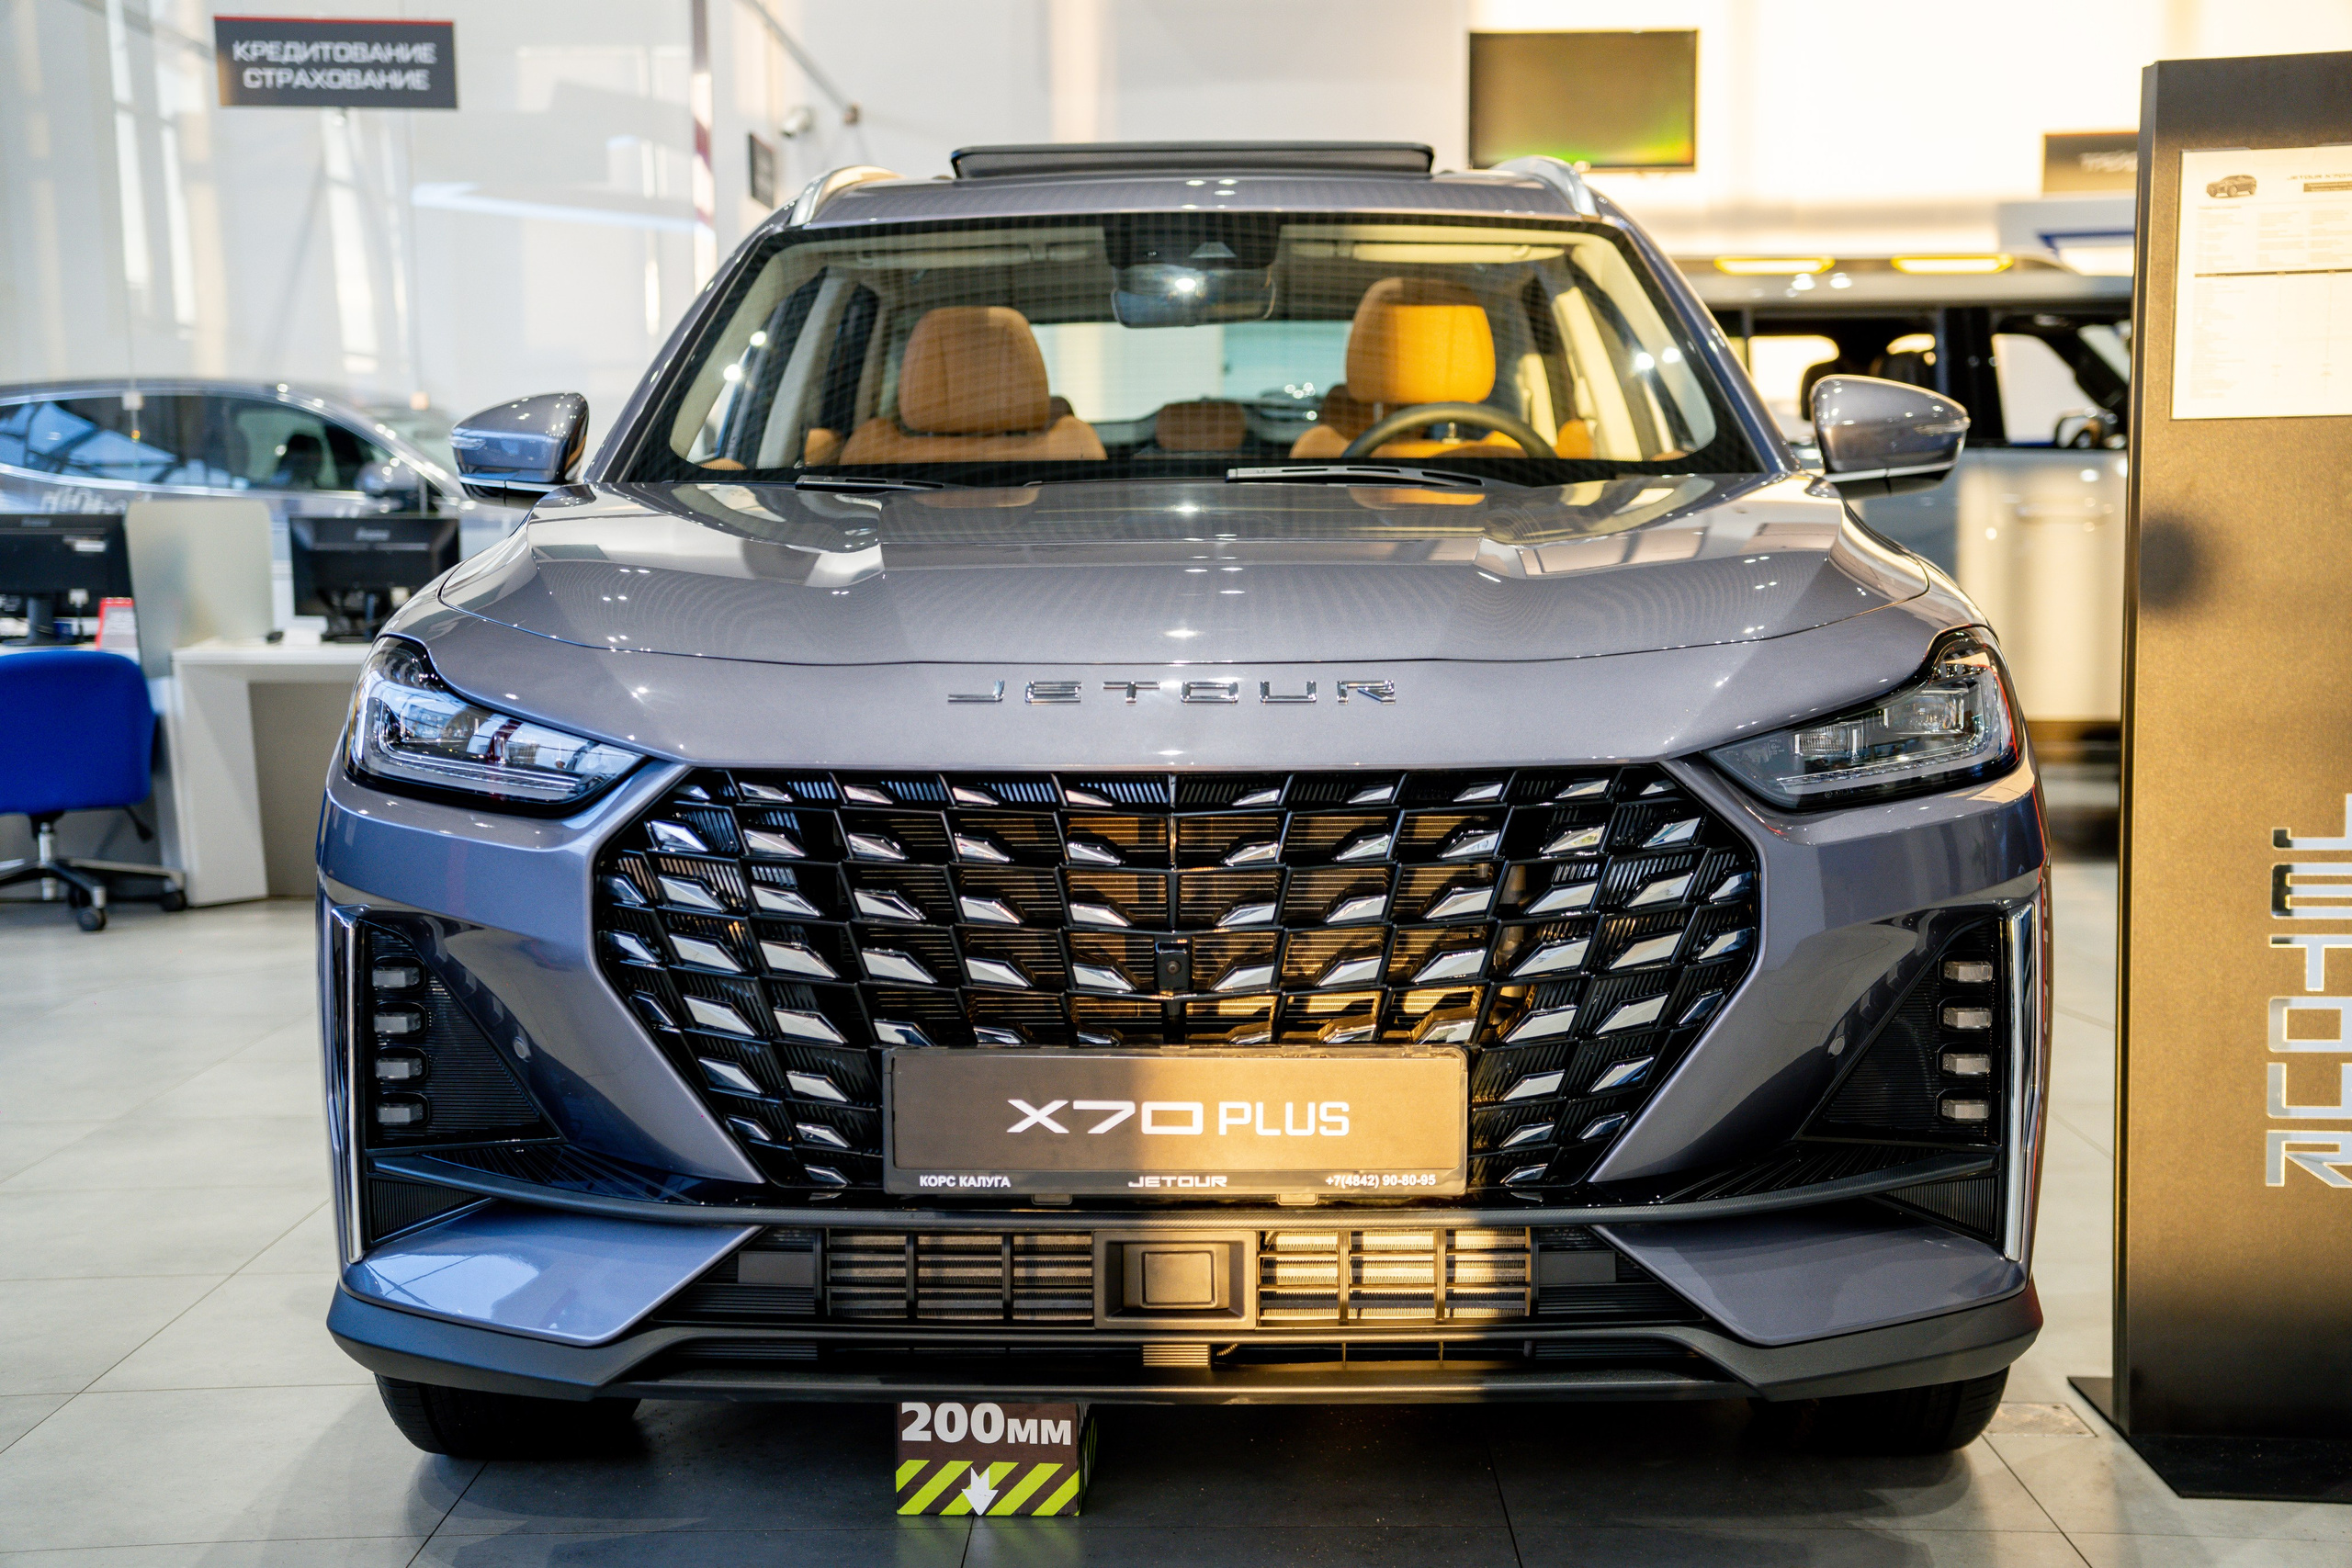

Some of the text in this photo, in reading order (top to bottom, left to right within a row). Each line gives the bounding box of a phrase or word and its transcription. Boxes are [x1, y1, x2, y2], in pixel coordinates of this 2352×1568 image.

[232, 40, 438, 64] КРЕДИТОВАНИЕ
[243, 67, 432, 91] СТРАХОВАНИЕ
[947, 680, 1396, 704] JETOUR
[1007, 1100, 1350, 1136] X70 PLUS
[919, 1175, 1012, 1188] КОРС КАЛУГА
[1127, 1175, 1228, 1188] JETOUR
[1325, 1173, 1437, 1189] +7(4842) 90-80-95
